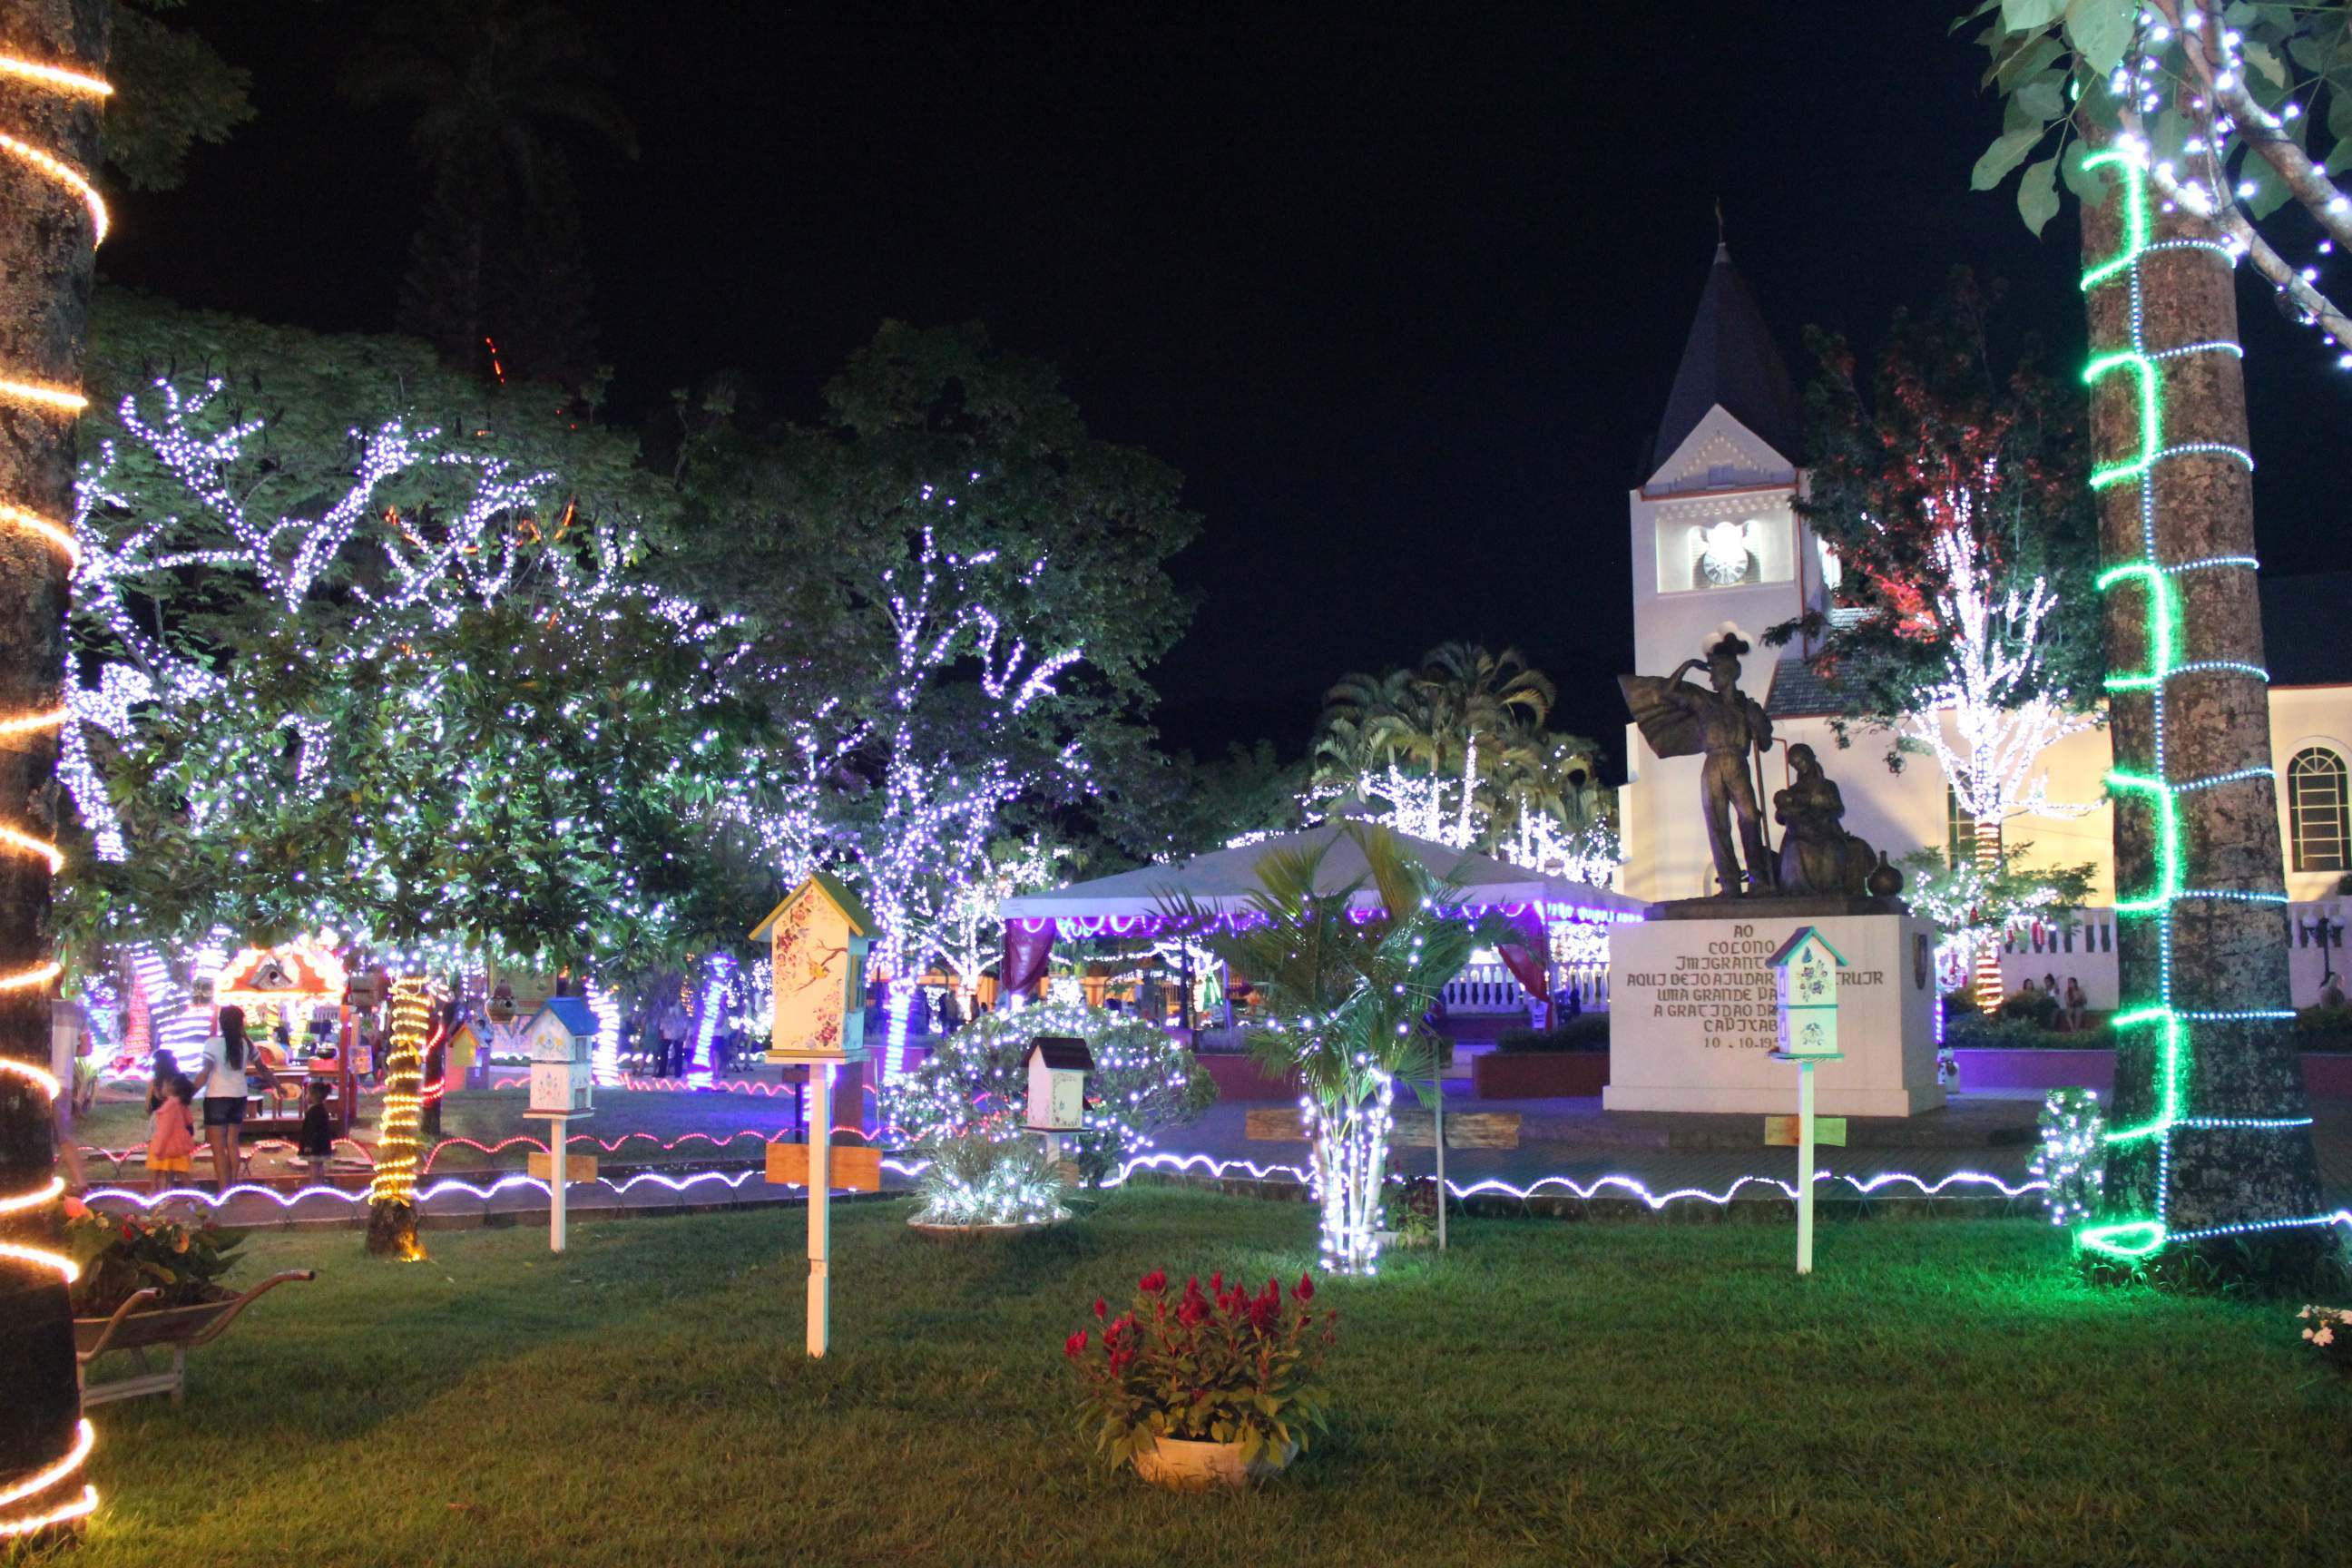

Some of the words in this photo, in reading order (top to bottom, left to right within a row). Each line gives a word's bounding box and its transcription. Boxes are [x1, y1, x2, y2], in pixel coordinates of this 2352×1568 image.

[1733, 924, 1753, 938] AO
[1709, 940, 1776, 955] COLONO
[1675, 956, 1765, 970] IMIGRANT
[1627, 973, 1666, 986] AQUI
[1713, 973, 1777, 986] AJUDAR
[1657, 988, 1689, 1002] UMA
[1693, 988, 1752, 1002] GRANDE
[1654, 1004, 1663, 1017] A
[1667, 1004, 1753, 1017] GRATIDAO
[1704, 1017, 1779, 1033] CAPIXAB
